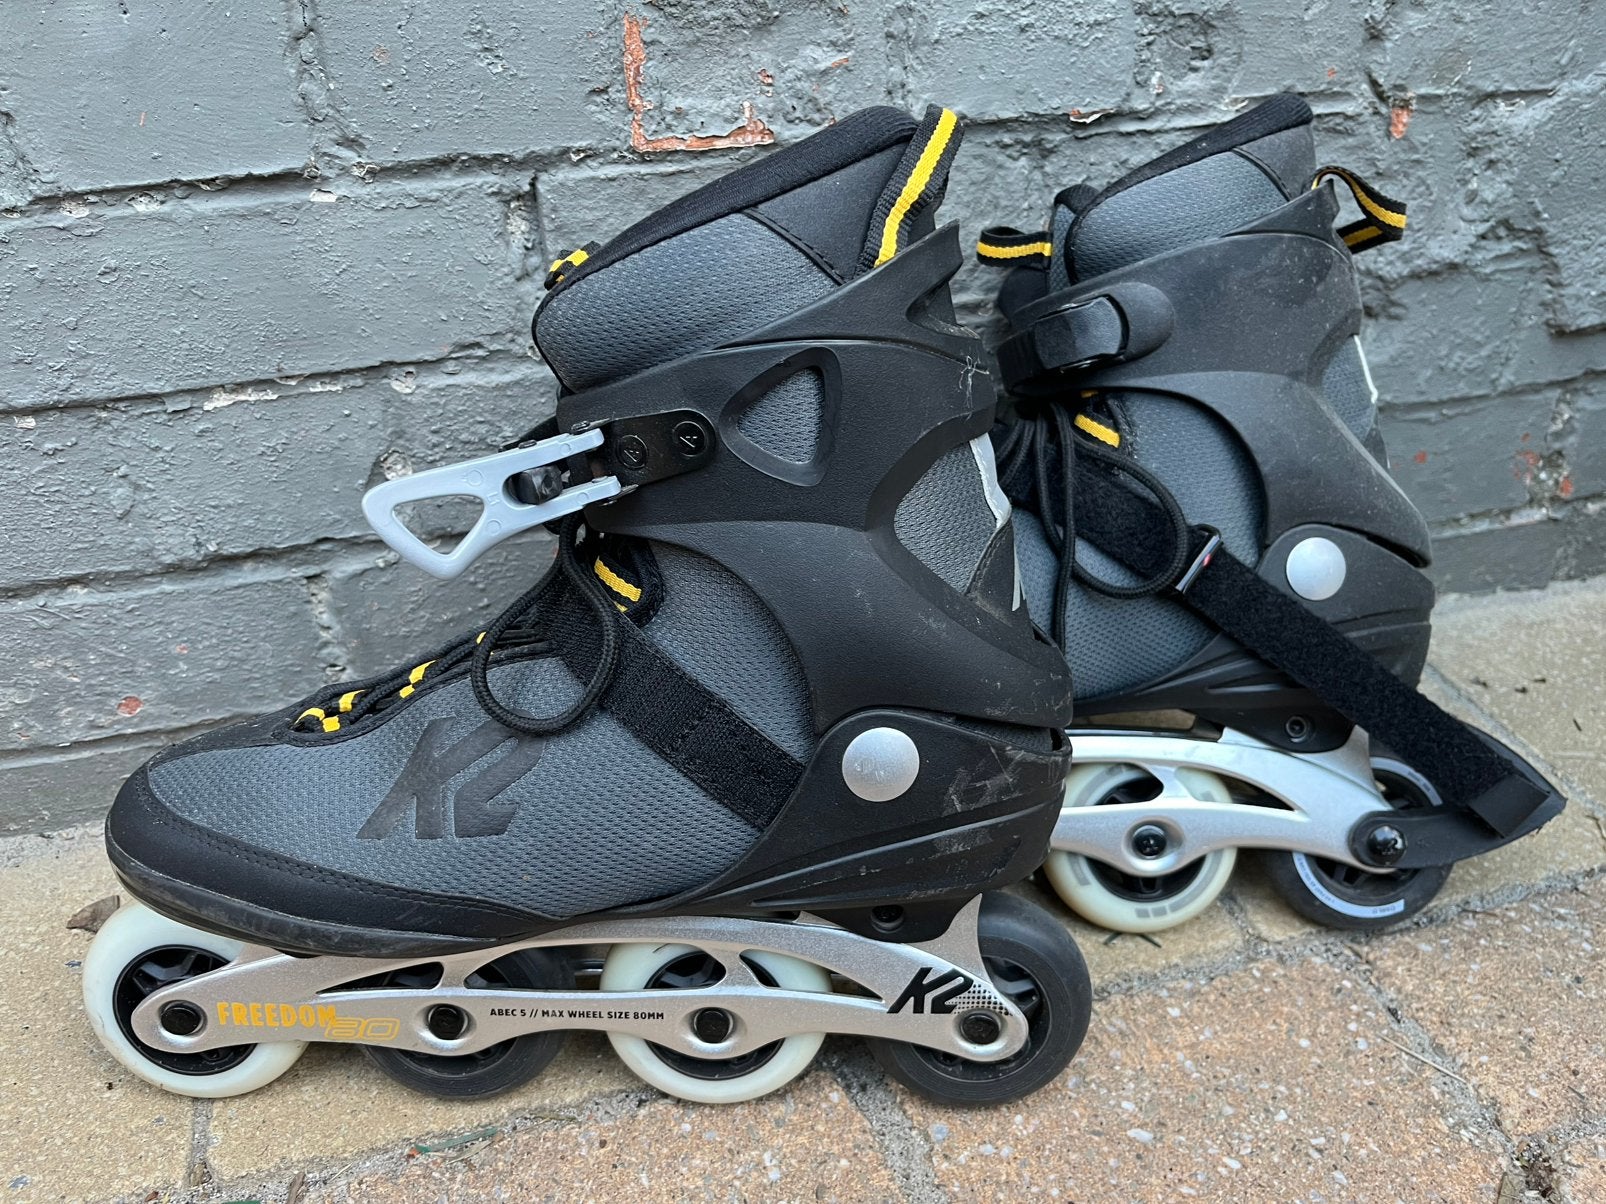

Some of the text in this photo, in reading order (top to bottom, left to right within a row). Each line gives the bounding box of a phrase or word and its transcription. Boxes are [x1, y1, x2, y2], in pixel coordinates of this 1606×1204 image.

[356, 717, 547, 839] K2
[886, 966, 974, 1014] K2
[217, 1003, 401, 1040] FREEDOM 80
[490, 1008, 517, 1017] ABEC
[520, 1009, 527, 1017] 5
[541, 1009, 565, 1018] MAX
[567, 1010, 604, 1019] WHEEL
[607, 1011, 631, 1019] SIZE
[633, 1011, 664, 1020] 80MM
